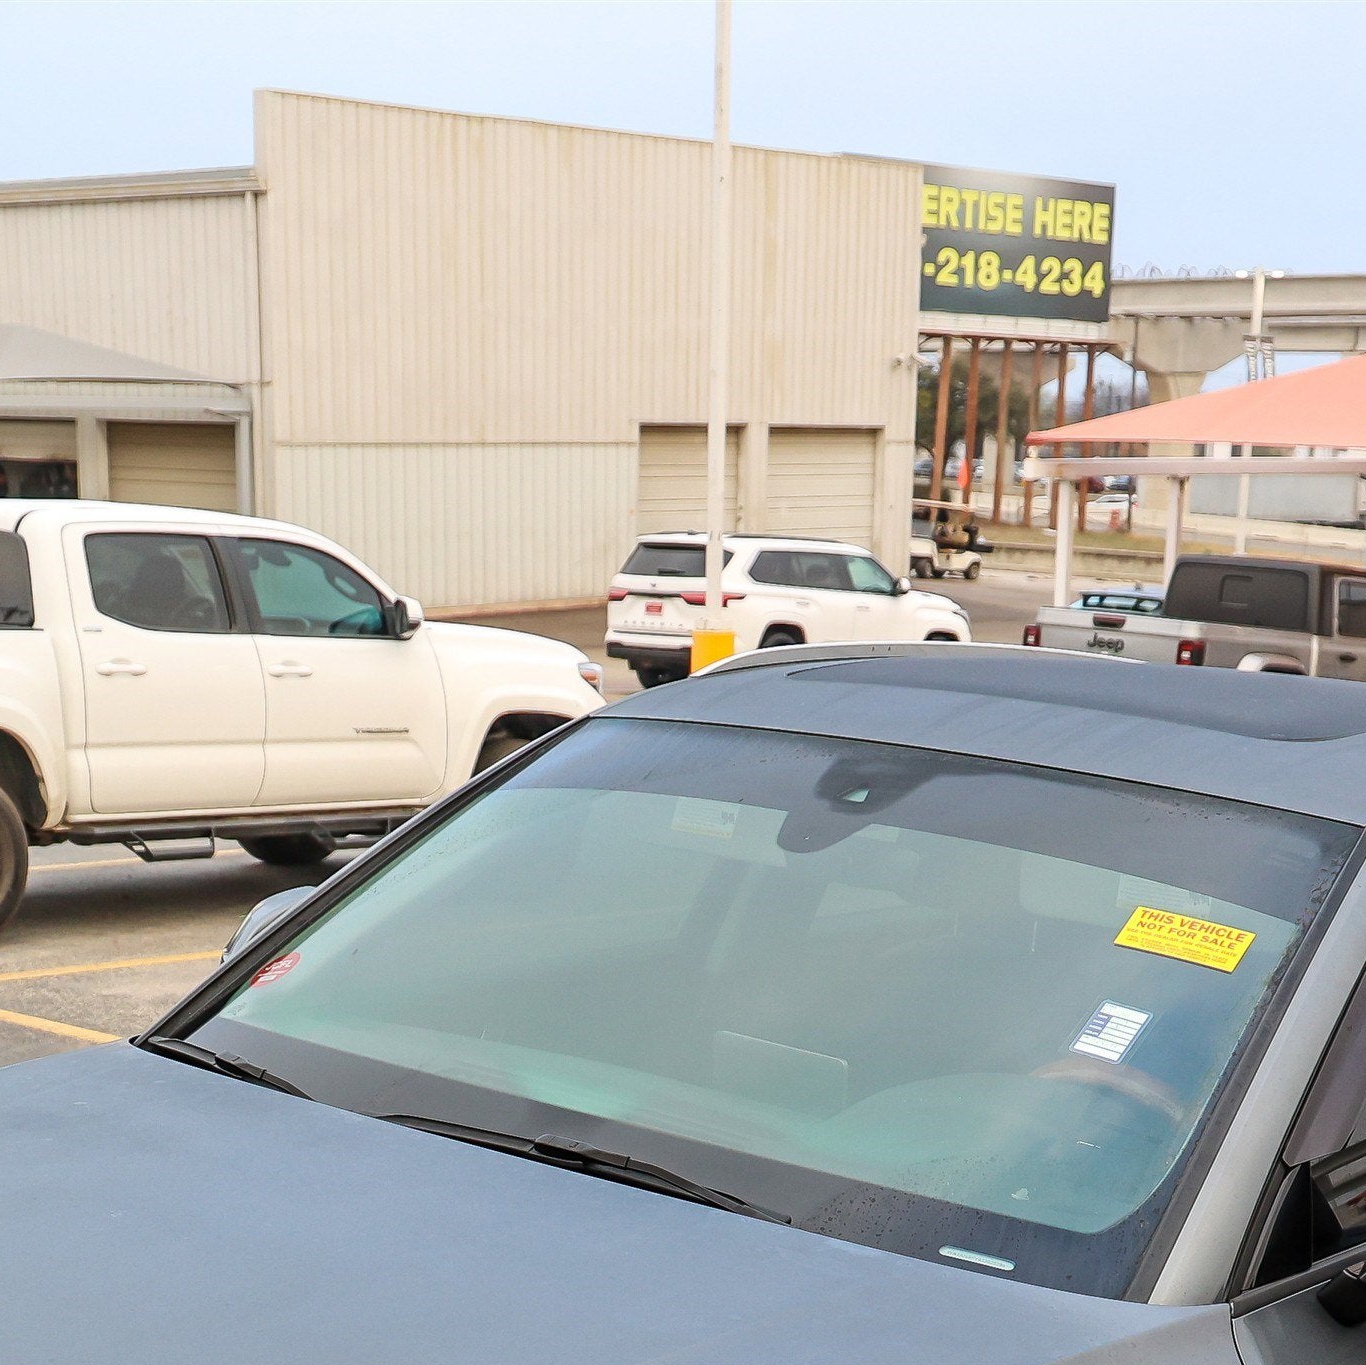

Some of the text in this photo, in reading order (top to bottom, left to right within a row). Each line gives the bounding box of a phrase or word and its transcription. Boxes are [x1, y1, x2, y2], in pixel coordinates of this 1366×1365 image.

[922, 183, 1111, 245] ERTISE HERE
[922, 246, 1106, 298] -218-4234
[1087, 632, 1125, 653] Jeep
[1136, 920, 1166, 932] NOT
[1168, 928, 1198, 940] FOR
[1200, 935, 1238, 950] SALE
[1139, 909, 1248, 942] THIS VEHICLE
